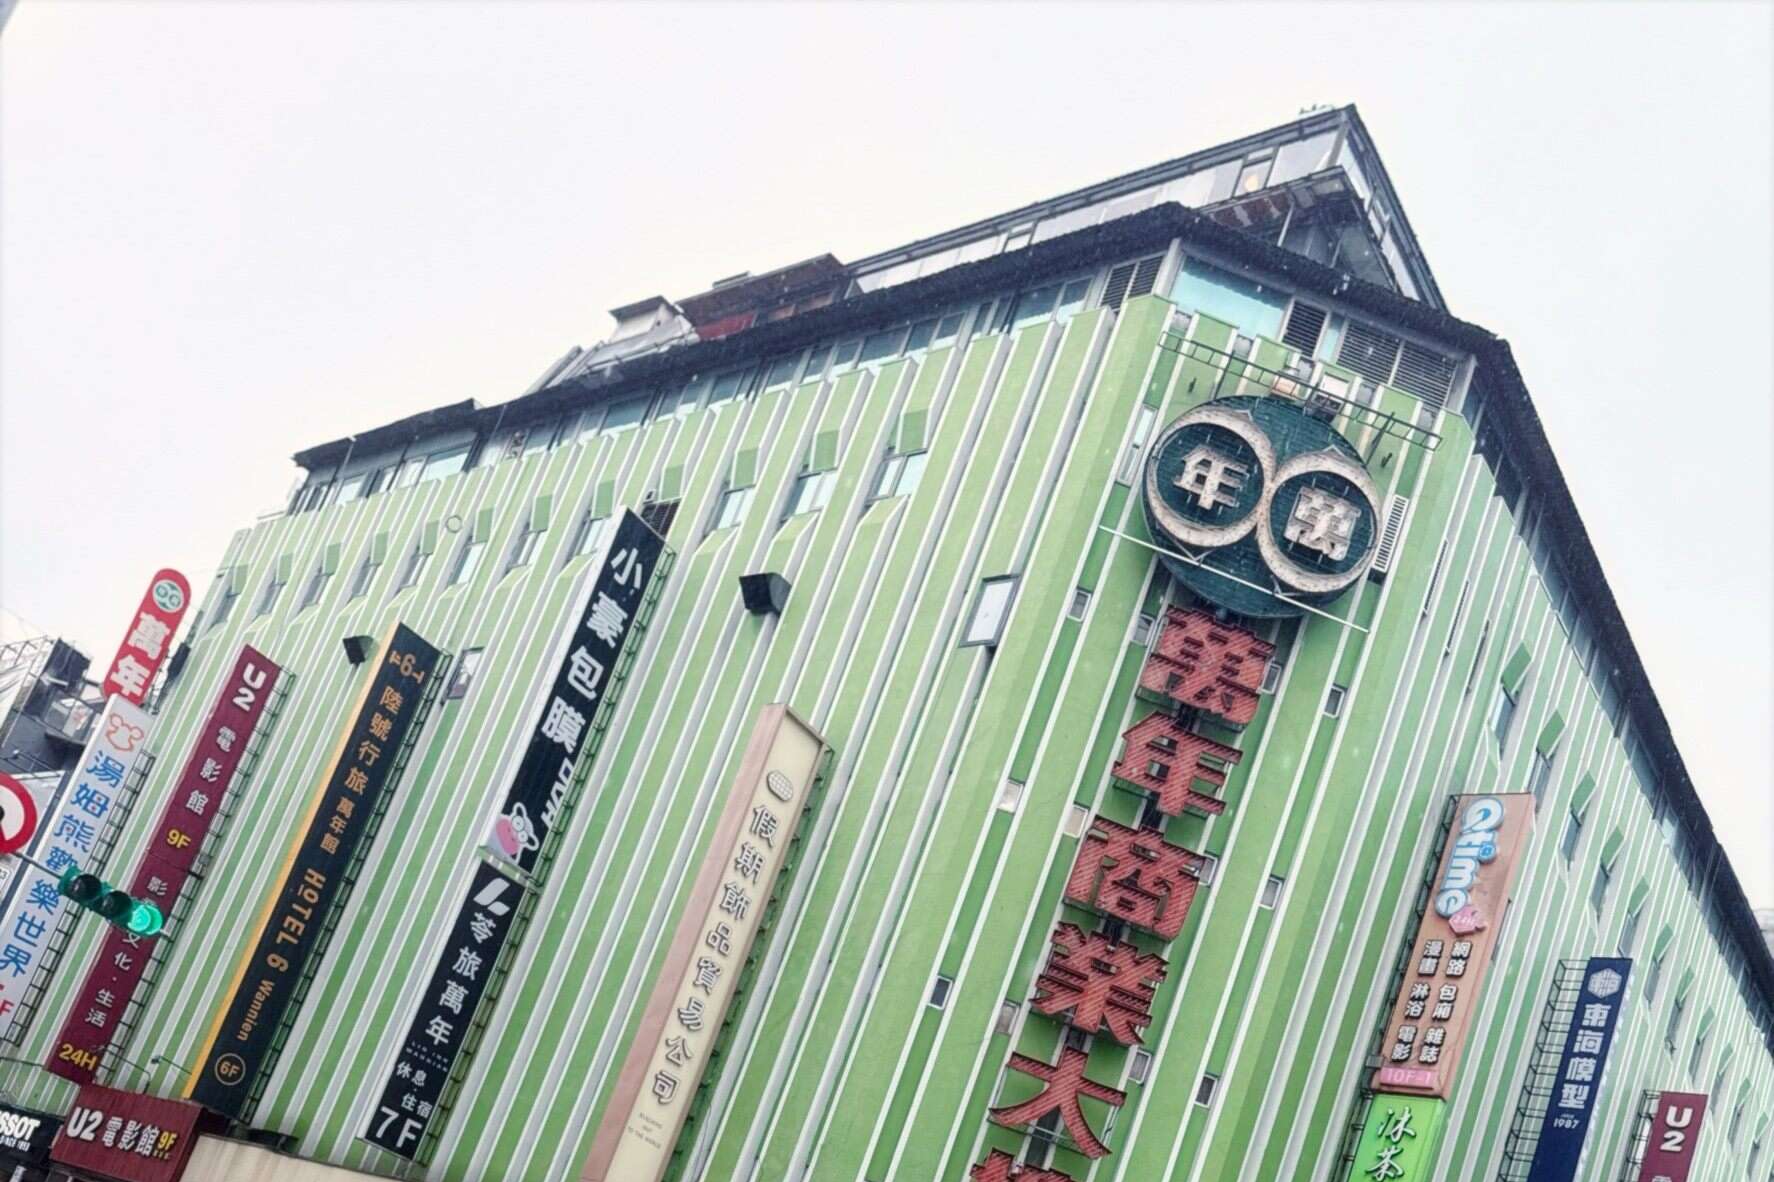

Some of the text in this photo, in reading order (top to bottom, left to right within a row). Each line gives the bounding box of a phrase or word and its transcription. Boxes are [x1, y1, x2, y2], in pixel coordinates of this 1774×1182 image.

[541, 548, 643, 754] 小豪包膜
[185, 726, 236, 816] 電影館
[344, 685, 403, 795] 陸號行旅
[167, 828, 191, 850] 9F
[276, 868, 326, 945] HOTEL
[425, 911, 496, 1045] 苓旅萬年
[59, 1043, 97, 1071] 24H
[221, 1062, 240, 1077] 6F
[1558, 1003, 1611, 1110] 東海模型
[66, 1106, 177, 1157] U2 電影館 9F
[376, 1106, 423, 1148] 7F
[1660, 1106, 1693, 1152] U2
